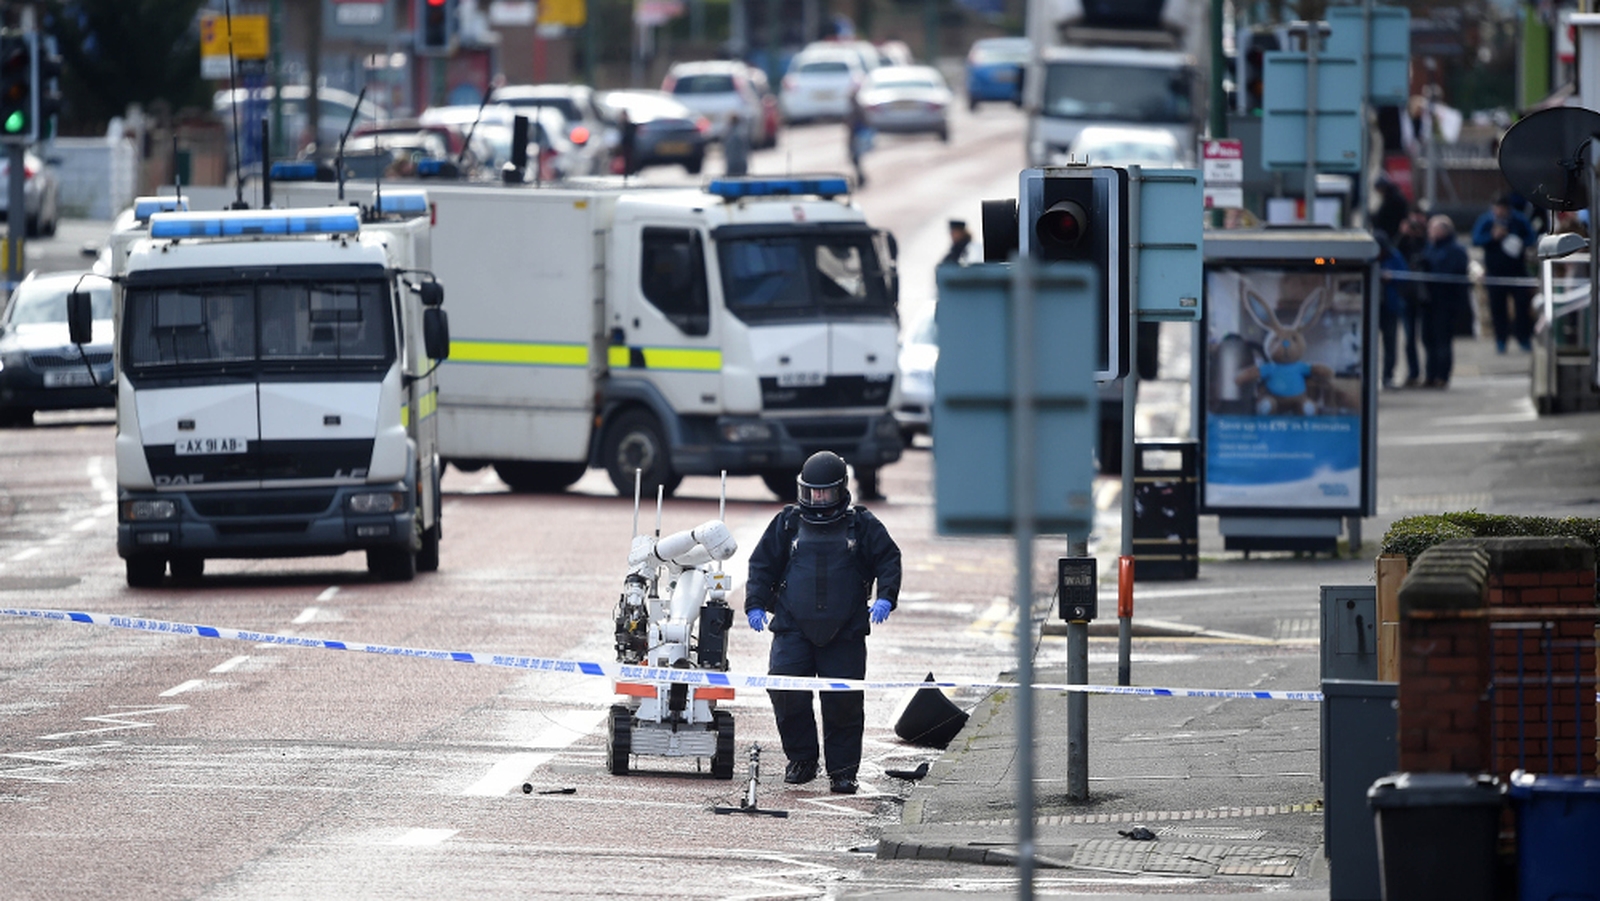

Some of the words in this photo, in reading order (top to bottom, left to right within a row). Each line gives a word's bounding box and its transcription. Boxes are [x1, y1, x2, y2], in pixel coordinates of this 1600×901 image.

[186, 440, 202, 452] AX
[221, 438, 237, 450] AB
[155, 474, 204, 486] DAF
[109, 616, 131, 628] POLICE
[621, 666, 642, 679] POLICE
[643, 669, 658, 679] LINE
